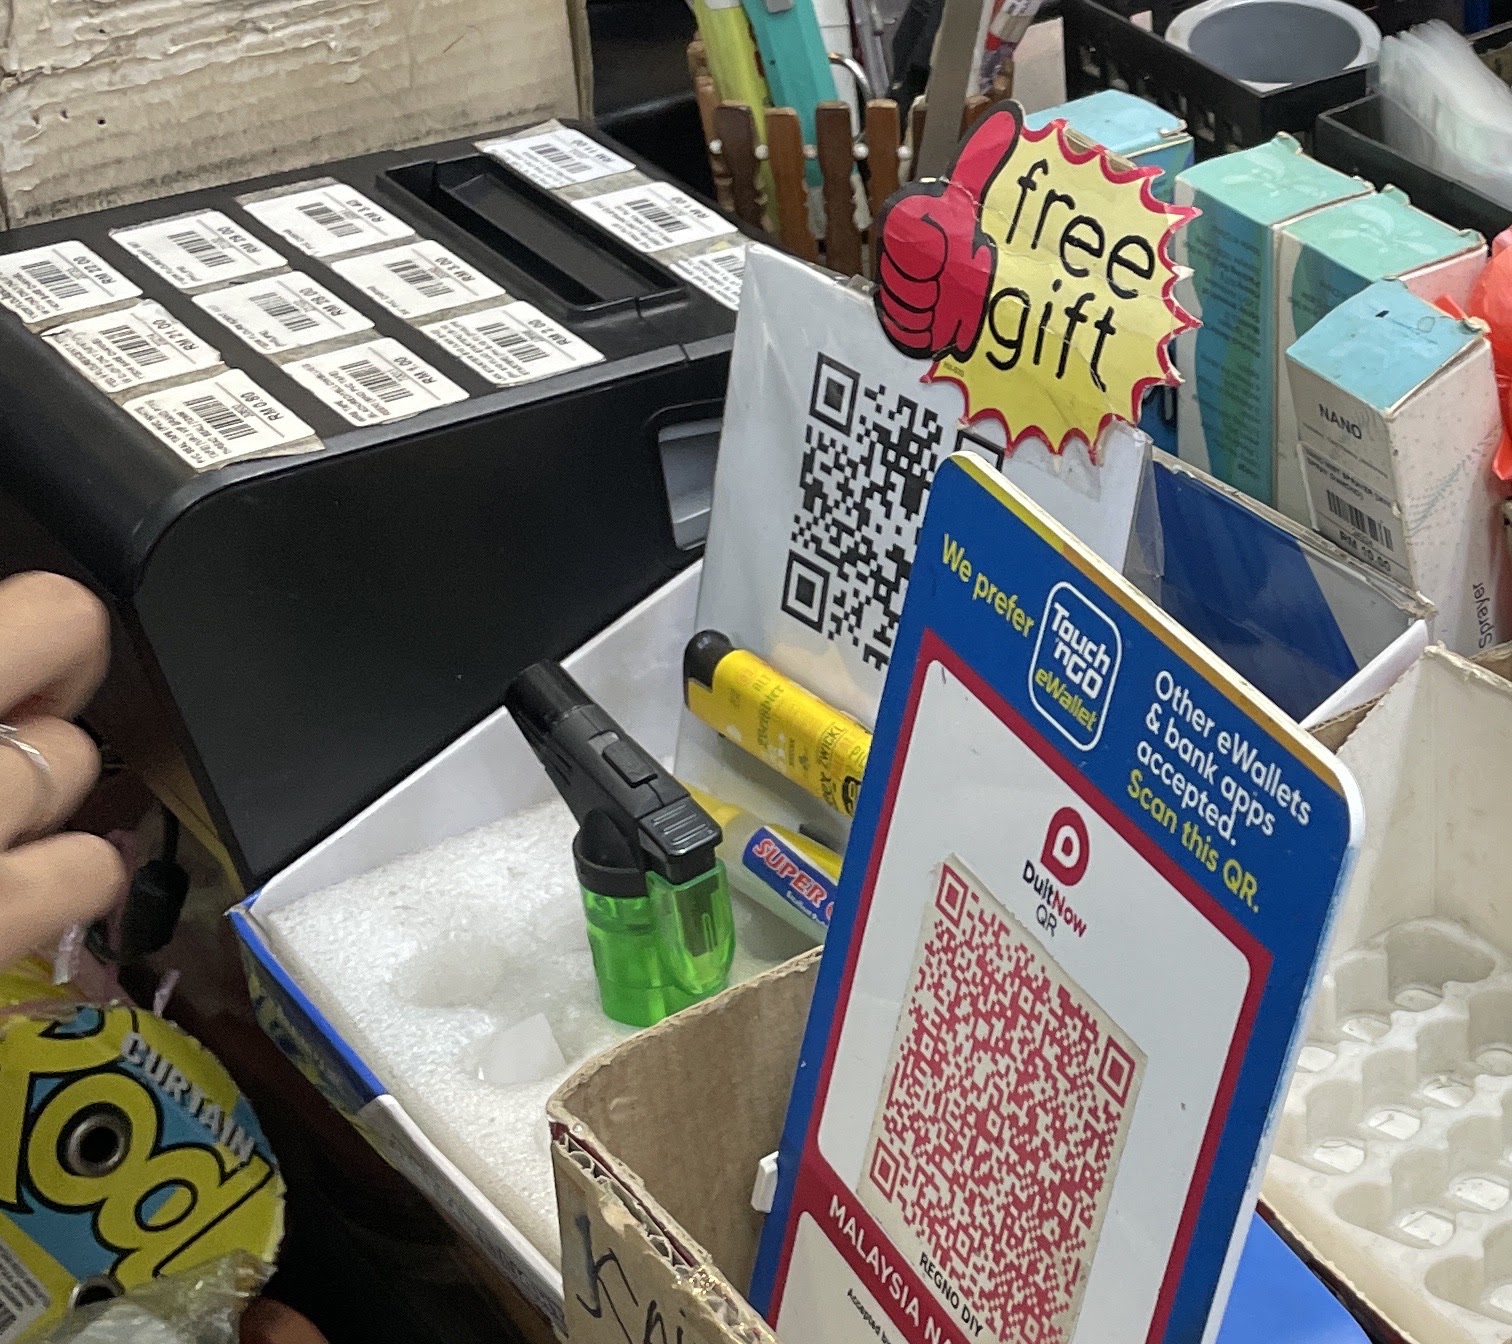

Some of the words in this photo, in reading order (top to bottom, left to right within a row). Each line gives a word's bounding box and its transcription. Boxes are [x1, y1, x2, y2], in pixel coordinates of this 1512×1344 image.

[361, 211, 386, 222] RM
[688, 208, 710, 218] RM
[1005, 158, 1156, 300] free
[70, 255, 103, 273] 22.00
[237, 242, 262, 253] RM
[93, 272, 117, 284] RM
[452, 270, 477, 282] RM
[150, 317, 184, 339] 21.00
[320, 304, 346, 317] RM
[174, 337, 198, 351] RM
[546, 332, 572, 345] RM
[985, 278, 1117, 393] gift
[392, 356, 420, 371] 1.00
[412, 371, 437, 384] RM
[238, 390, 268, 408] 0.80
[258, 406, 284, 421] RM
[1318, 402, 1363, 441] NANO
[942, 533, 973, 584] We
[972, 571, 1035, 639] prefer
[1472, 581, 1497, 650] Sprayer
[1049, 601, 1111, 674] Touch
[1034, 666, 1098, 733] eWallet
[1154, 669, 1214, 738] Other
[1217, 730, 1312, 826] eWallets
[1144, 703, 1160, 736] &
[1164, 718, 1220, 785] bank
[1219, 773, 1276, 837] apps
[1136, 740, 1238, 846] accepted.
[1126, 768, 1178, 834] Scan
[1181, 819, 1220, 874] this
[752, 837, 829, 908] SUPER
[1022, 859, 1088, 940] DuitNow
[1035, 901, 1058, 938] QR
[121, 1031, 255, 1163] CURTAIN
[829, 1193, 920, 1327] MALAYSIA
[918, 1250, 960, 1311] REGNO
[961, 1305, 985, 1338] DIY
